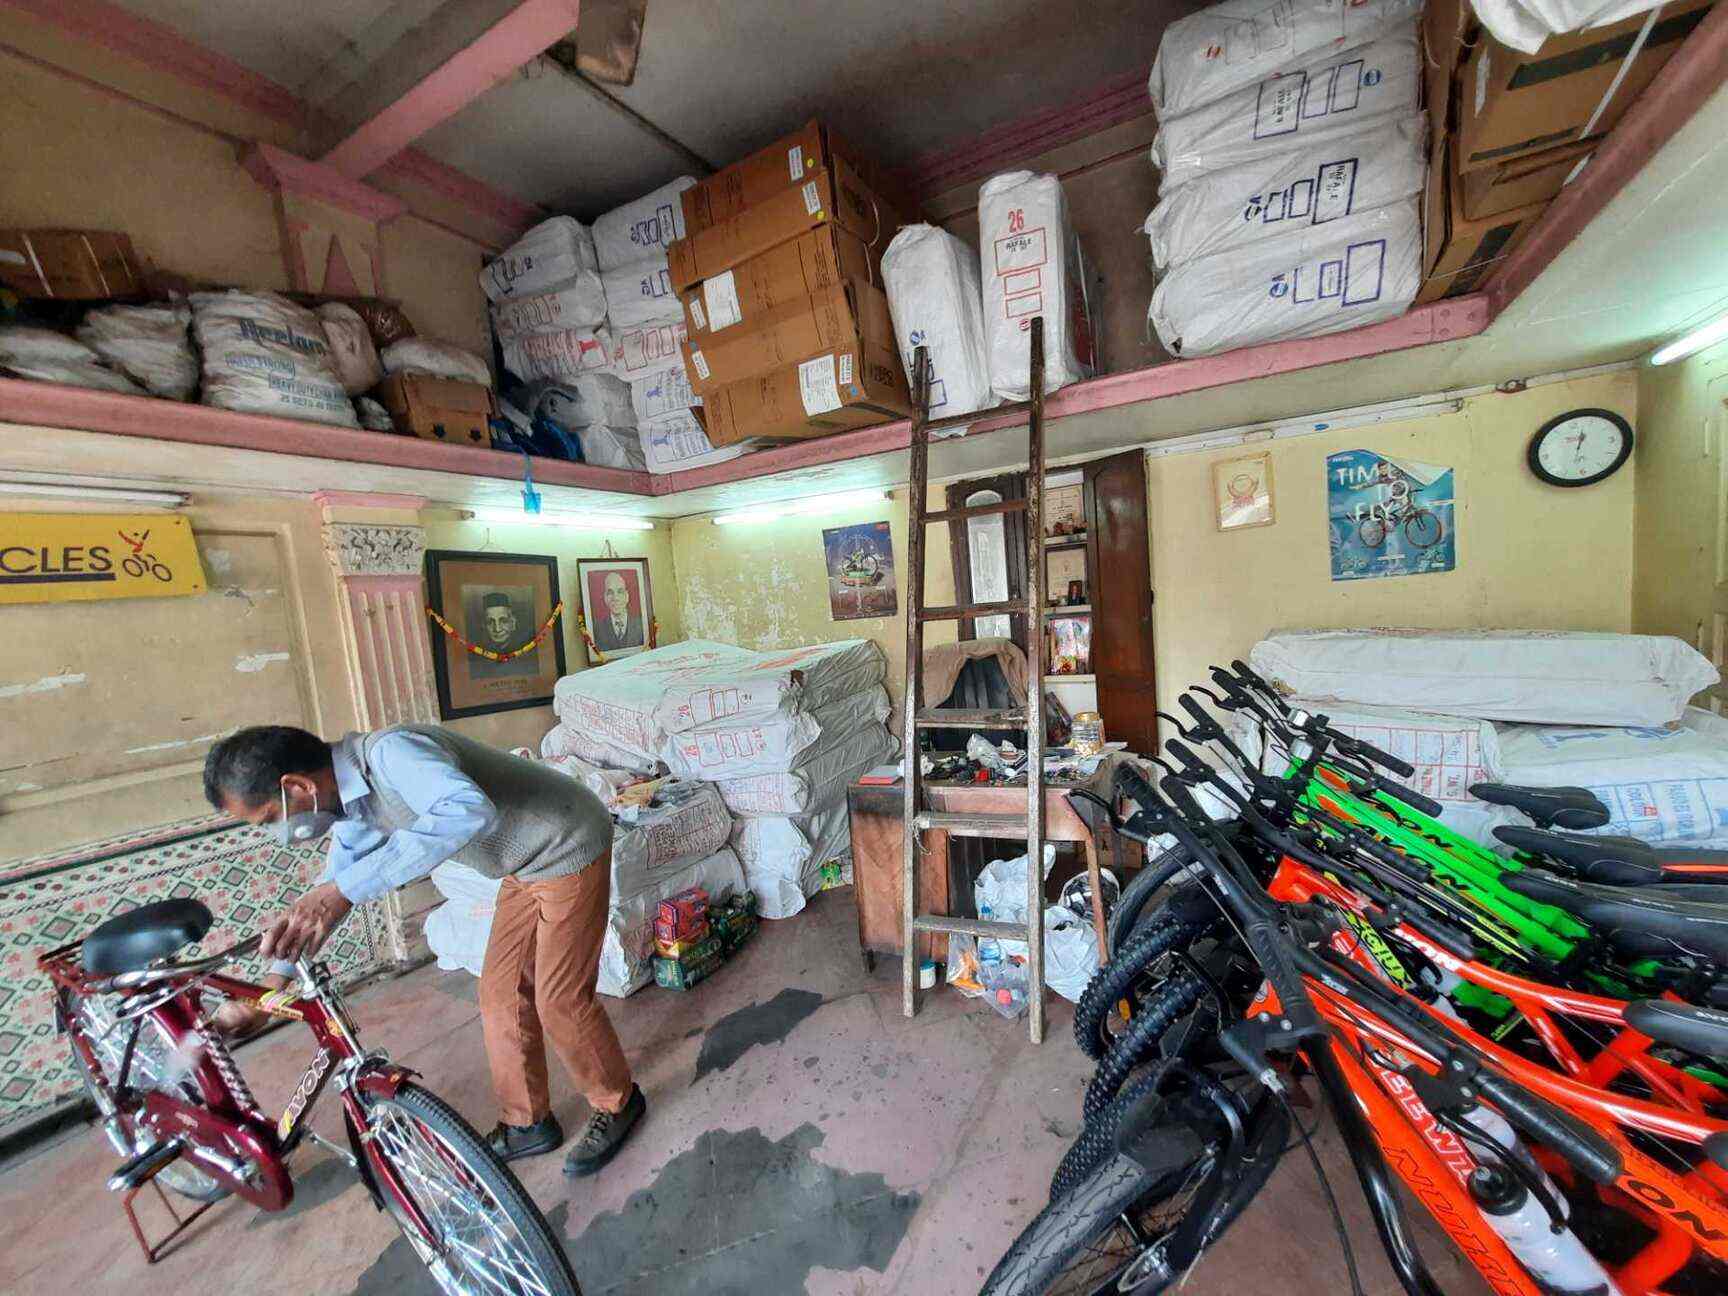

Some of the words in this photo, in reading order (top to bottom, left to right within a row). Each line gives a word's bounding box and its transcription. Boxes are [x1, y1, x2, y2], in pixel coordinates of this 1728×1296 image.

[1007, 208, 1024, 233] 26
[1355, 501, 1394, 521] FLY
[0, 546, 113, 574] CLES
